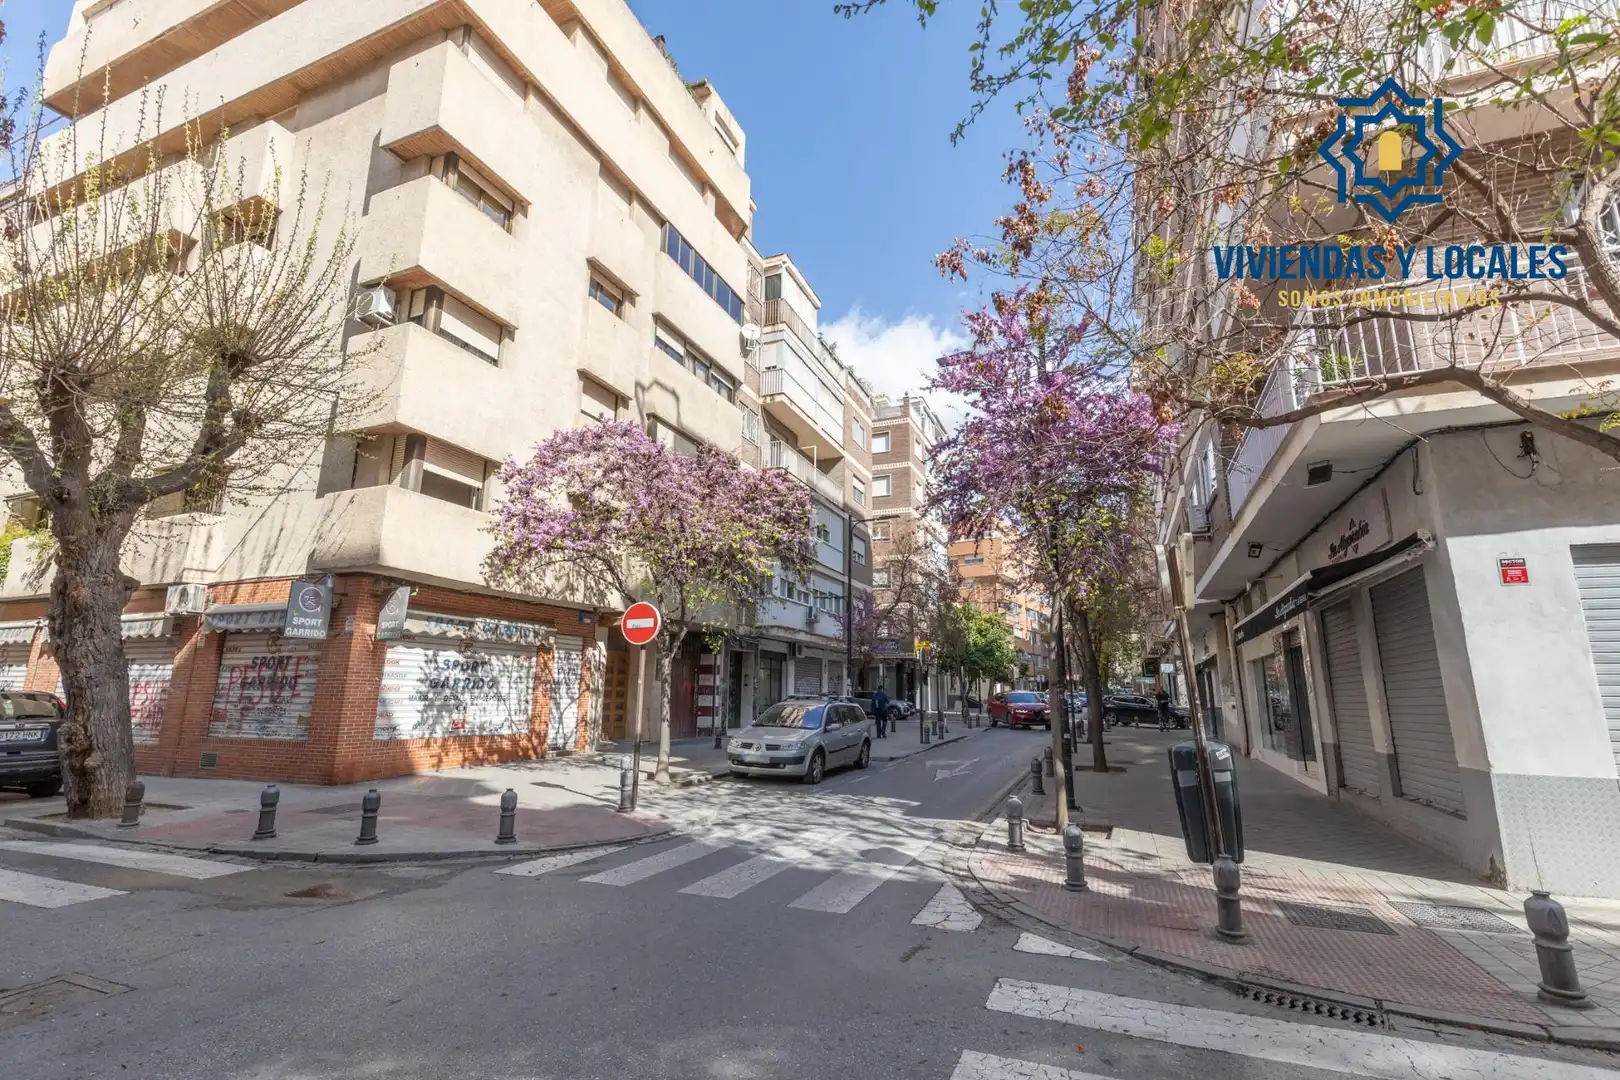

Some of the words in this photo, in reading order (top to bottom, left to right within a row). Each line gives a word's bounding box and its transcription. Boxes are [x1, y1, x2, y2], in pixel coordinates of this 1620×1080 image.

[292, 616, 323, 627] SPORT
[380, 620, 400, 630] SPORT
[285, 627, 326, 638] GARRIDO
[251, 655, 292, 668] SPORT
[442, 659, 488, 673] SPORT
[429, 677, 497, 690] GARRIDO
